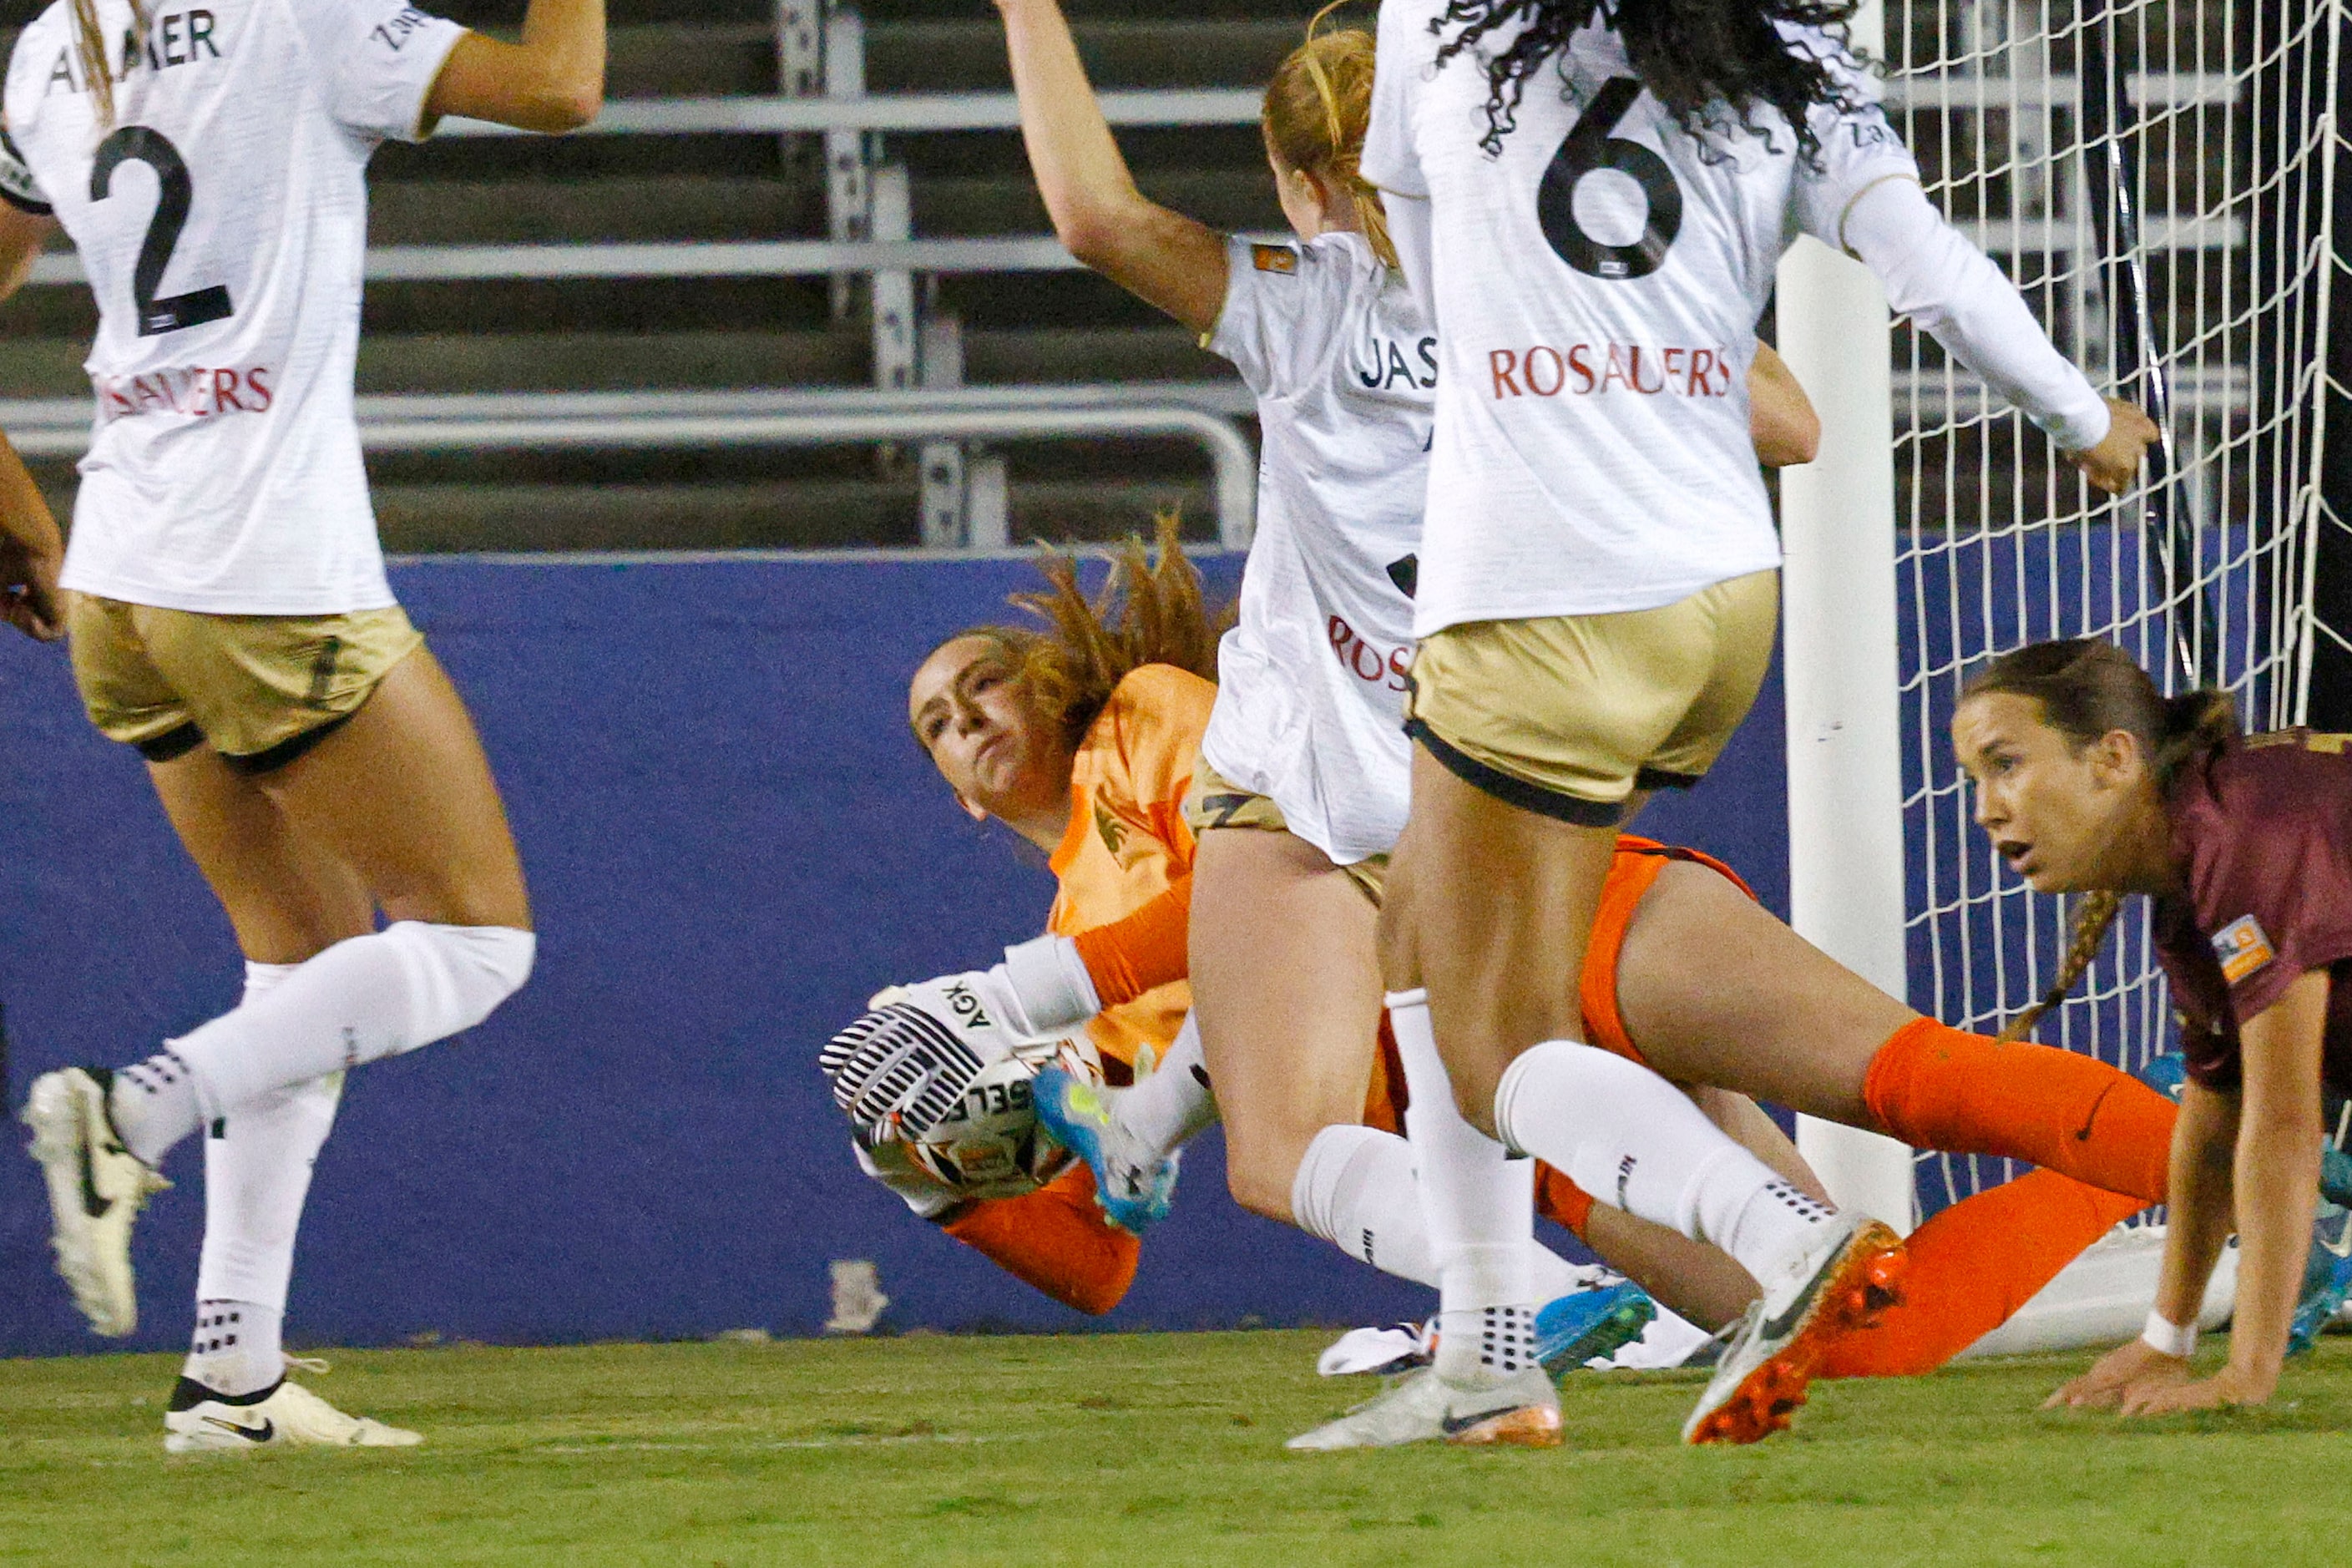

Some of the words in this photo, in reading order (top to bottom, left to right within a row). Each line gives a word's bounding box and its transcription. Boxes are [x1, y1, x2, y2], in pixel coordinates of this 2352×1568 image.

[90, 125, 233, 336] 2
[1538, 76, 1682, 280] 6
[1490, 342, 1731, 400] ROSAUERS
[942, 979, 991, 1029] AGK
